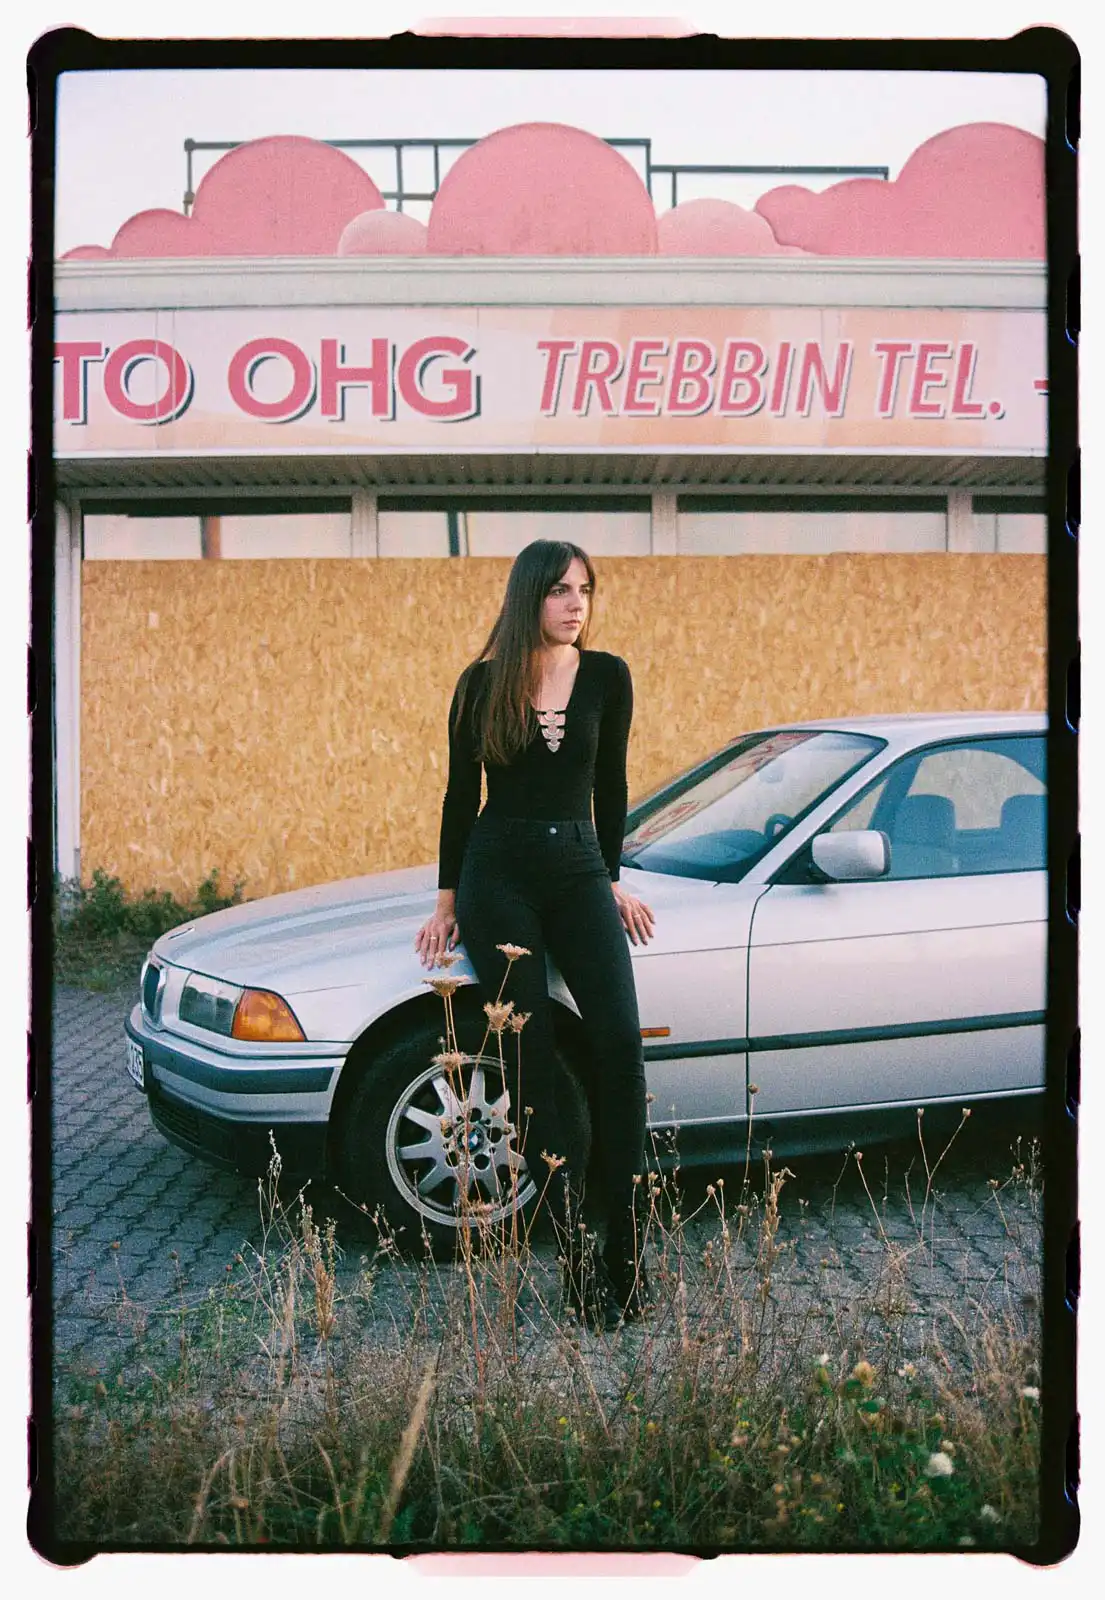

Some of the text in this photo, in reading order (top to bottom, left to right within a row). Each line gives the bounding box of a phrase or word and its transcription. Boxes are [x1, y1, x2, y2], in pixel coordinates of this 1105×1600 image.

[54, 336, 1006, 425] TO OHG TREBBIN TEL.
